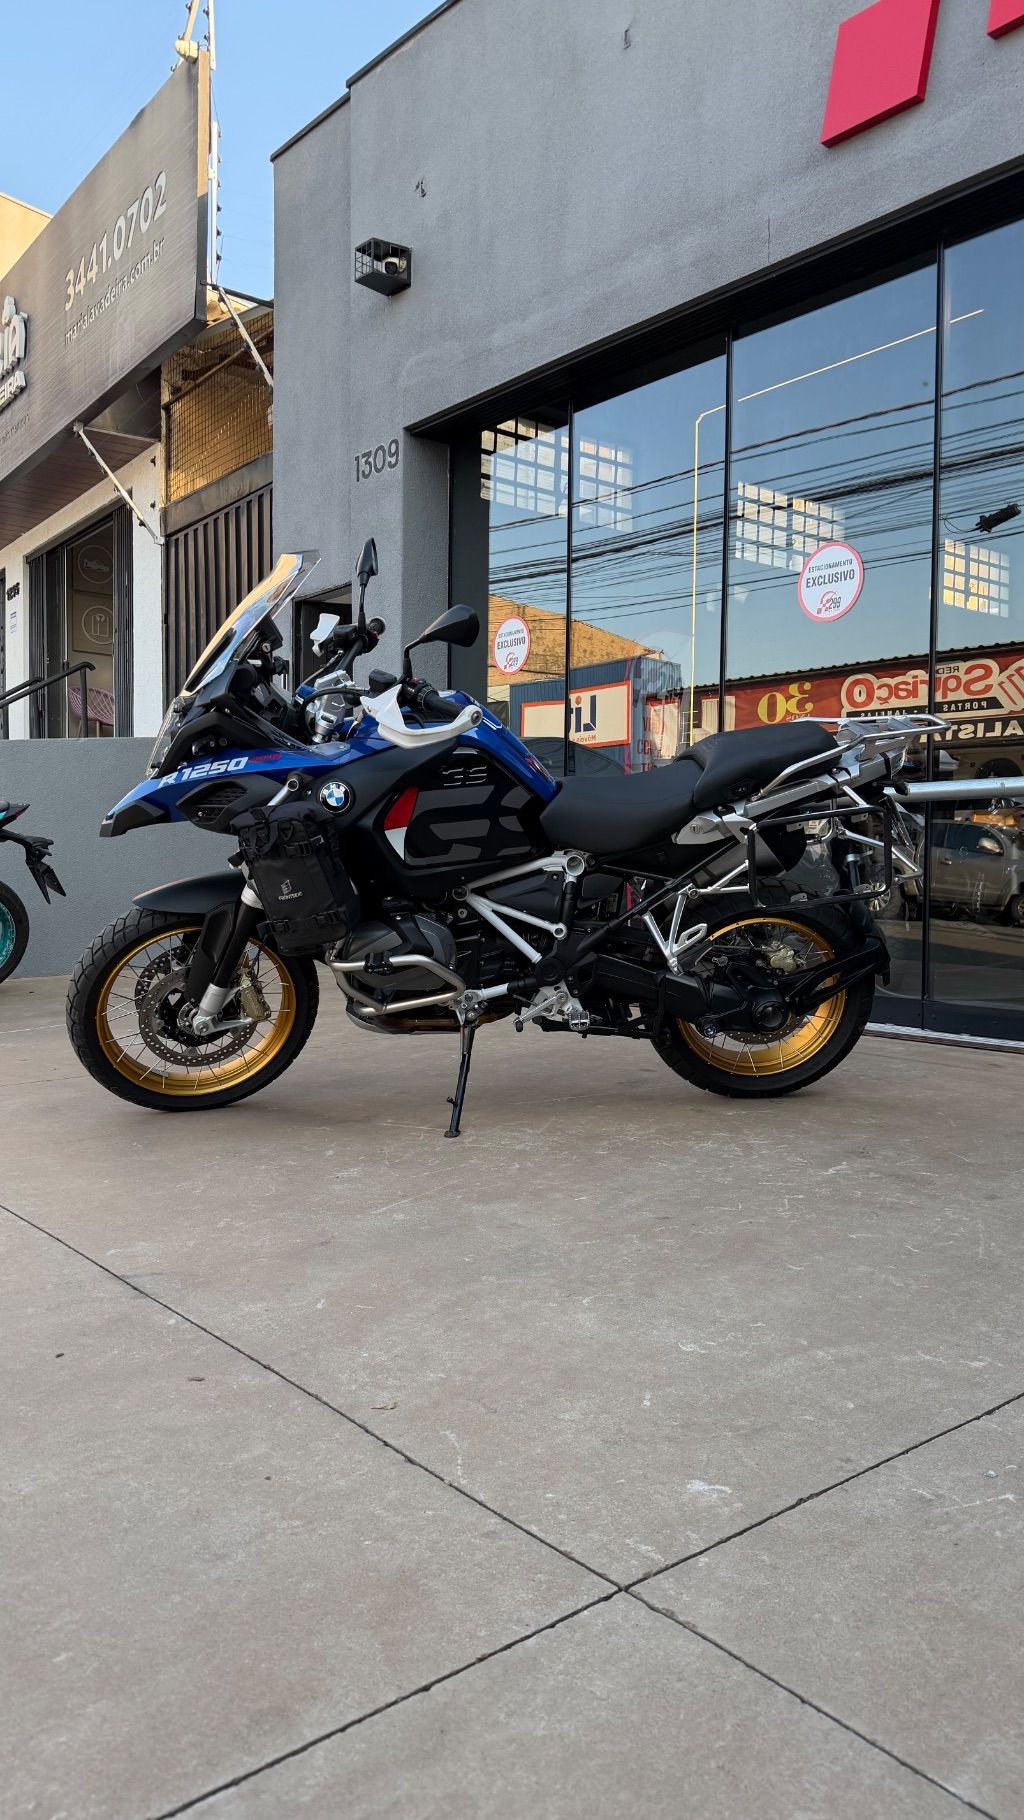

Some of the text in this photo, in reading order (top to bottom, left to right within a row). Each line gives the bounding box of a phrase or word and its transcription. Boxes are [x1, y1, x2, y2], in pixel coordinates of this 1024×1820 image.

[64, 171, 167, 312] 3441.0702
[354, 438, 400, 482] 1309
[808, 558, 853, 573] ESTACIONAMENTO
[805, 568, 855, 588] EXCLUSIVO
[497, 636, 526, 650] EXCLUSIVO
[179, 756, 249, 782] 1250
